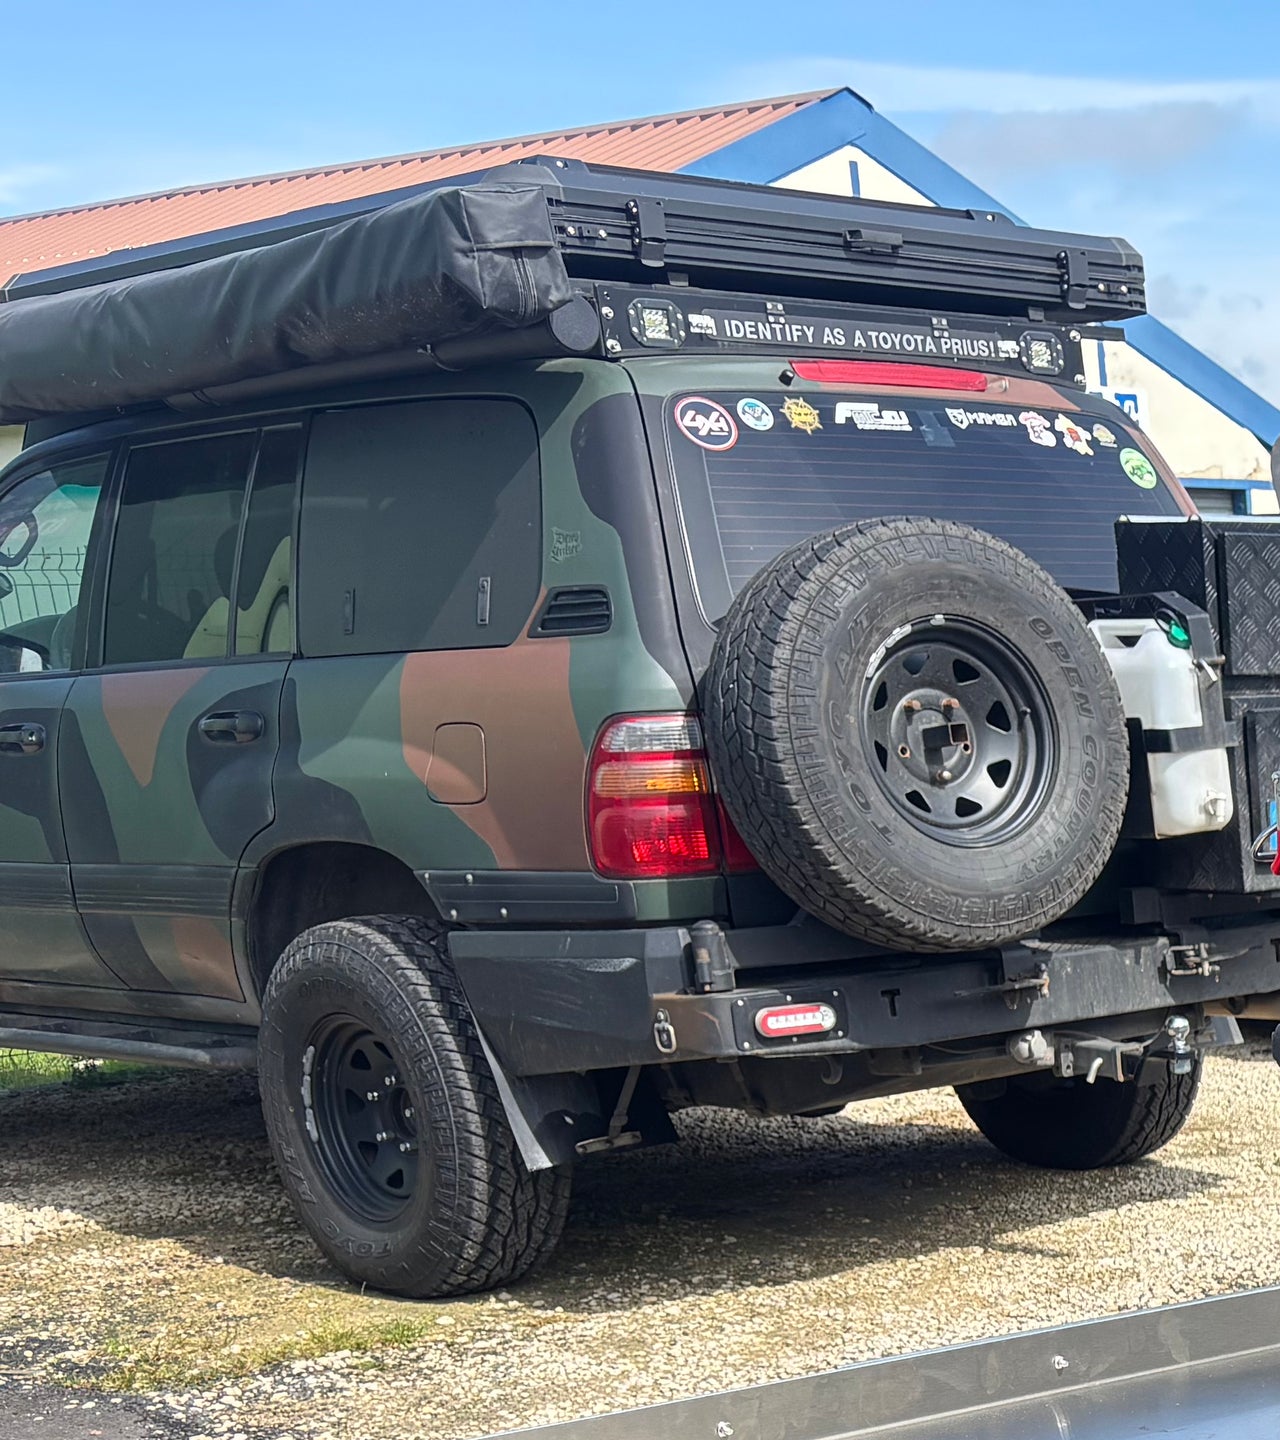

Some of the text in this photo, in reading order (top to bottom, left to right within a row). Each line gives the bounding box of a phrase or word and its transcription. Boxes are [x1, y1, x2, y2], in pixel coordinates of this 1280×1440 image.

[724, 319, 815, 343] IDENTIFY
[823, 327, 846, 346] AS
[854, 330, 866, 348] A
[868, 331, 937, 353] TOYOTA
[942, 338, 996, 357] PRIUS!
[1014, 616, 1099, 884] OPEN COUNTRY
